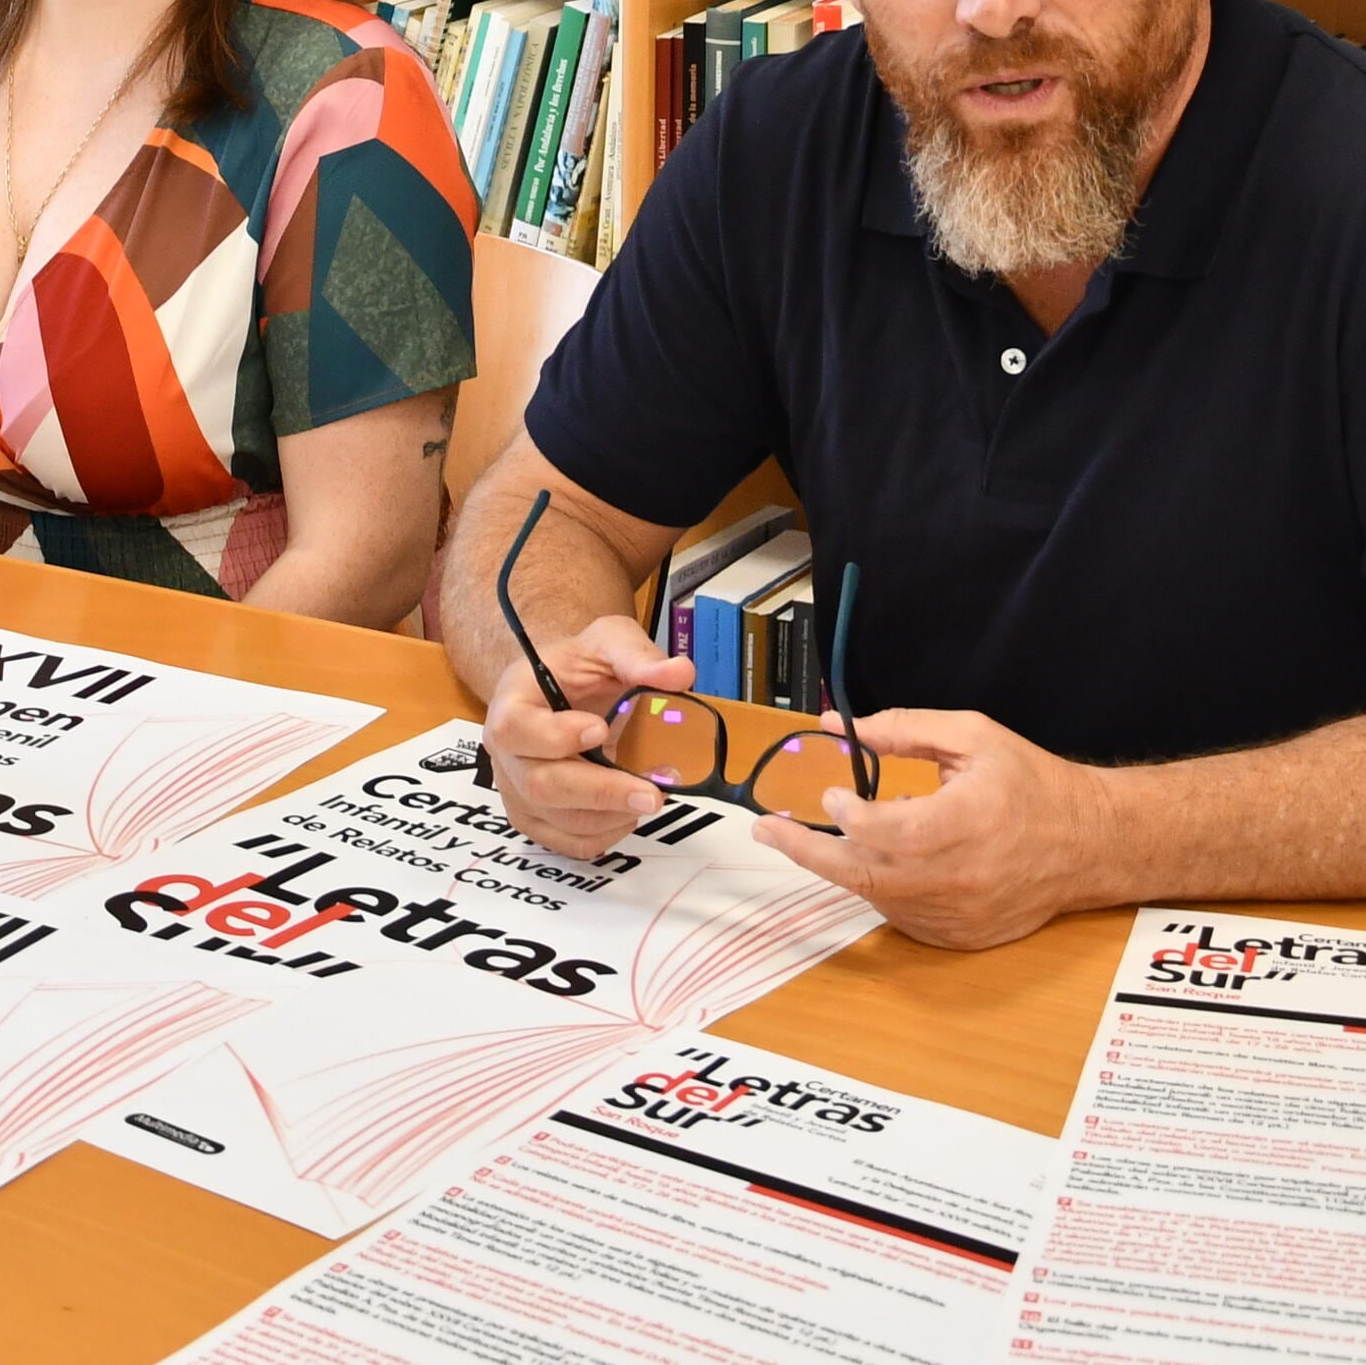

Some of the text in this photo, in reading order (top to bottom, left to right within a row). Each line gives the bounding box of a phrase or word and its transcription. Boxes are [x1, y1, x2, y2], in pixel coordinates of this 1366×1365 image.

[282, 812, 568, 913] de Relatos Cortos
[319, 794, 437, 841] Infantil
[438, 836, 462, 851] y
[470, 843, 613, 894] Juvenil
[134, 872, 357, 950] del
[1152, 942, 1261, 973] del
[1145, 983, 1242, 1001] San Roque
[634, 1070, 751, 1113] del
[805, 1080, 901, 1115] Certamen
[590, 1105, 680, 1140] San Roque
